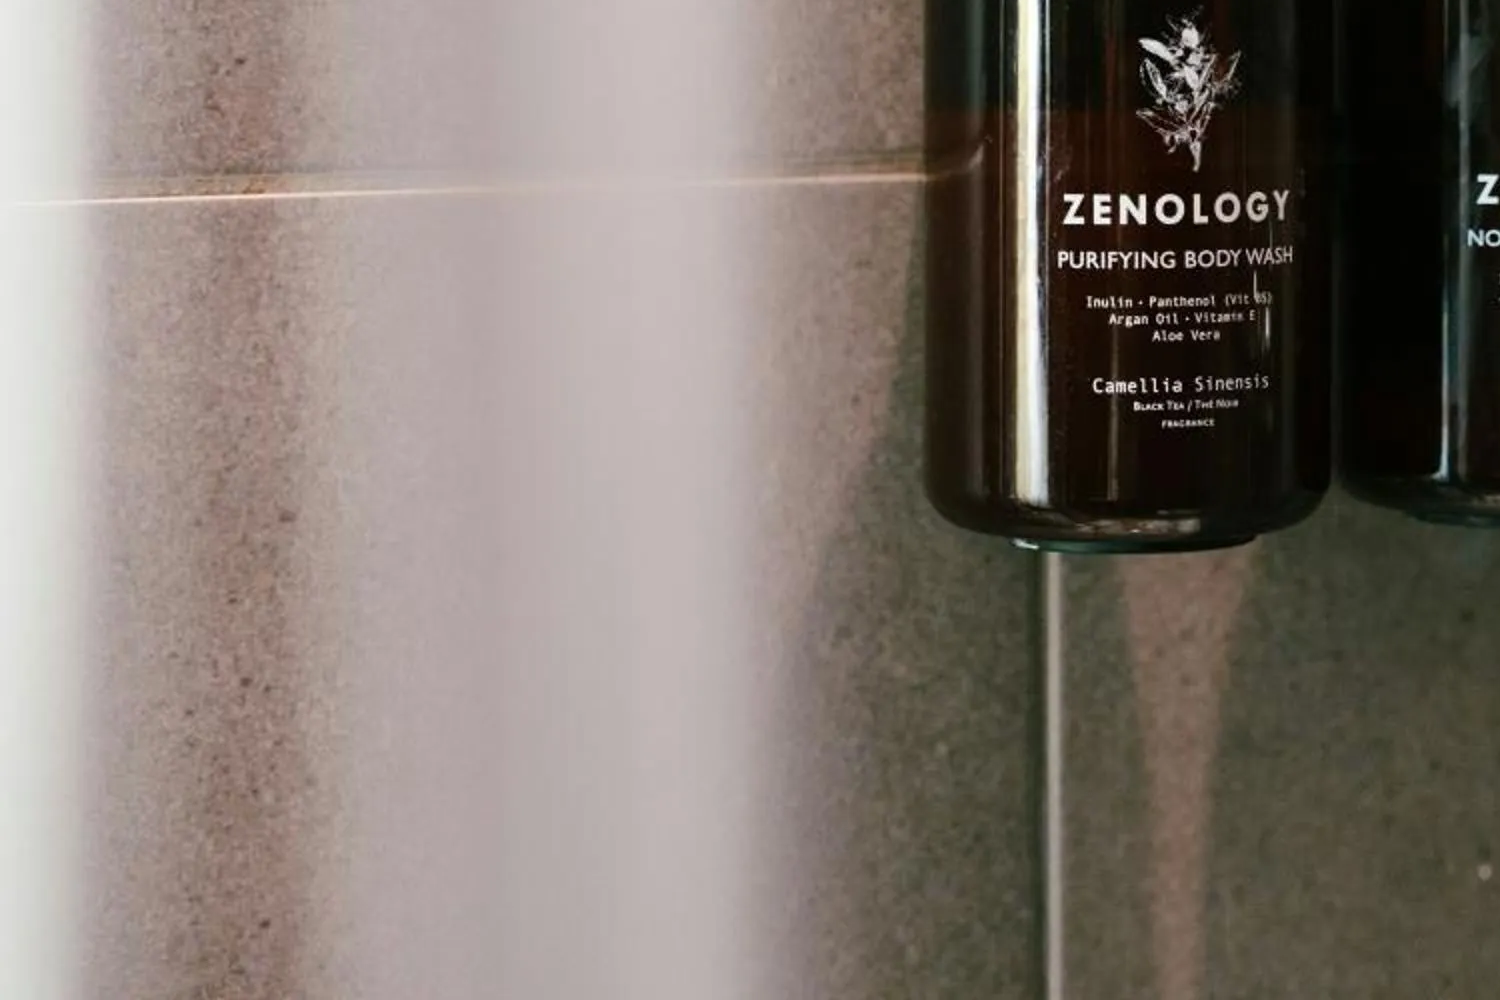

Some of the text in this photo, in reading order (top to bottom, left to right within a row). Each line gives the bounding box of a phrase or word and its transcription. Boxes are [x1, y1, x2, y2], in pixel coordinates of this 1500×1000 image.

[1062, 189, 1290, 226] ZENOLOGY
[1057, 245, 1293, 269] PURIFYING BODY WASH
[1086, 295, 1133, 309] Inulin
[1149, 293, 1217, 308] Panthenol
[1108, 312, 1149, 328] Argan
[1155, 312, 1180, 326] Oil
[1151, 329, 1221, 342] Aloe Vera
[1092, 373, 1270, 395] Camellia Sinensis
